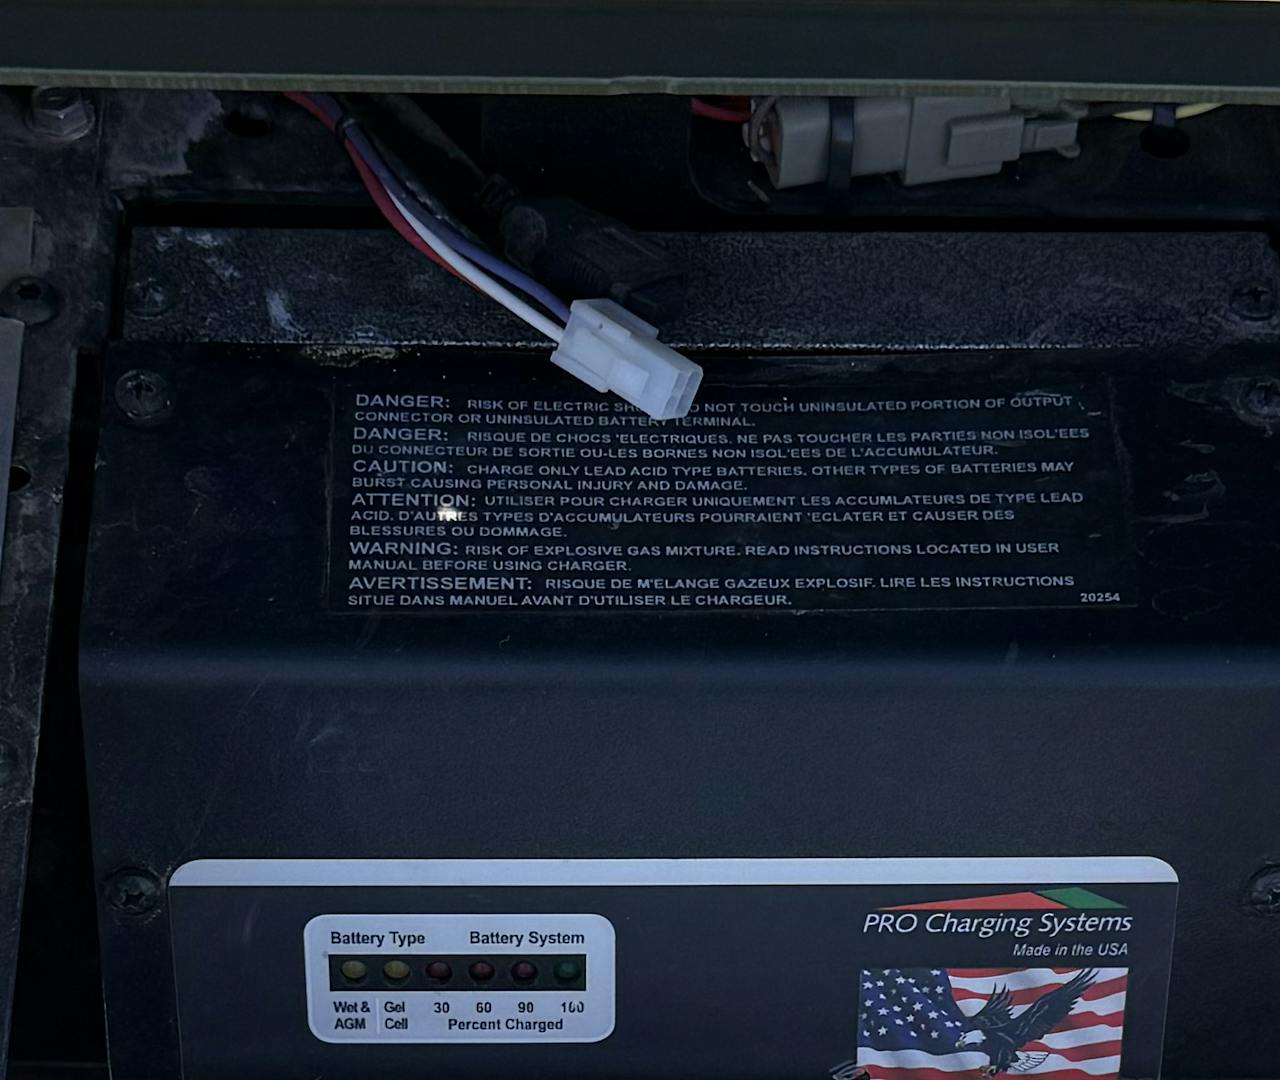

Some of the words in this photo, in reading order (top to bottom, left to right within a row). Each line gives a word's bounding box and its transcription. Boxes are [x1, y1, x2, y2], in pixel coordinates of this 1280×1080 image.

[352, 458, 453, 477] CAUTION:
[466, 464, 534, 475] CHARGE
[538, 465, 580, 475] ONLY
[583, 465, 626, 476] LEAD
[629, 465, 667, 476] ACID
[671, 465, 712, 476] TYPE
[716, 465, 809, 476] BATTERIES.
[811, 464, 866, 476] OTHER
[868, 463, 920, 474] TYPES
[924, 463, 946, 474] OF
[950, 461, 1037, 473] BATTERIES
[1040, 461, 1074, 472] MAY
[351, 476, 407, 487] BURST
[408, 477, 482, 488] CAUSING
[486, 479, 573, 490] PERSONAL
[577, 479, 633, 490] INJURY
[636, 480, 670, 490] AND
[674, 479, 747, 490] DAMAGE.
[349, 524, 446, 536] BLESSURES
[449, 525, 474, 536] OU
[479, 526, 567, 537] DOMMAGE.
[348, 541, 458, 555] WARNING:
[464, 544, 502, 555] RISK
[506, 544, 530, 555] OF
[533, 545, 623, 556] EXPLOSIVE
[626, 545, 660, 556] GAS
[665, 545, 741, 556] MIXTURE.
[744, 545, 790, 555] READ
[794, 544, 912, 555] INSTRUCTIONS
[916, 543, 991, 554] LOCATED
[995, 543, 1011, 553] IN
[1015, 542, 1059, 553] USER
[348, 559, 418, 570] MANUAL
[422, 559, 491, 570] BEFORE
[492, 560, 542, 570] USING
[546, 560, 631, 571] CHARGER.
[348, 576, 532, 590] AVERTISSEMENT:
[545, 578, 606, 589] RISQUE
[610, 578, 632, 588] DE
[634, 578, 720, 588] M'ELANGE
[724, 578, 790, 588] GAZEUX
[794, 577, 876, 588] EXPLOSIF.
[879, 576, 916, 588] LIRE
[920, 576, 951, 587] LES
[955, 575, 1074, 587] INSTRUCTIONS
[1080, 592, 1120, 602] 20254
[864, 914, 918, 933] PRO
[925, 913, 1032, 938] Charging
[1039, 913, 1132, 938] Systems
[331, 932, 384, 947] Battery
[389, 932, 426, 947] Type
[470, 932, 523, 946] Battery
[528, 932, 585, 947] System
[1013, 943, 1051, 957] Made
[1055, 943, 1067, 956] in
[1070, 943, 1093, 956] the
[1098, 943, 1128, 956] USA
[334, 1002, 359, 1013] Wet
[360, 1002, 370, 1013] &
[384, 1002, 405, 1013] Gel
[434, 1003, 450, 1013] 30
[476, 1002, 492, 1013] 60
[518, 1002, 534, 1013] 90
[334, 1020, 366, 1030] AGM
[384, 1019, 408, 1030] Cell
[448, 1019, 500, 1030] Percent
[505, 1019, 563, 1032] Charged
